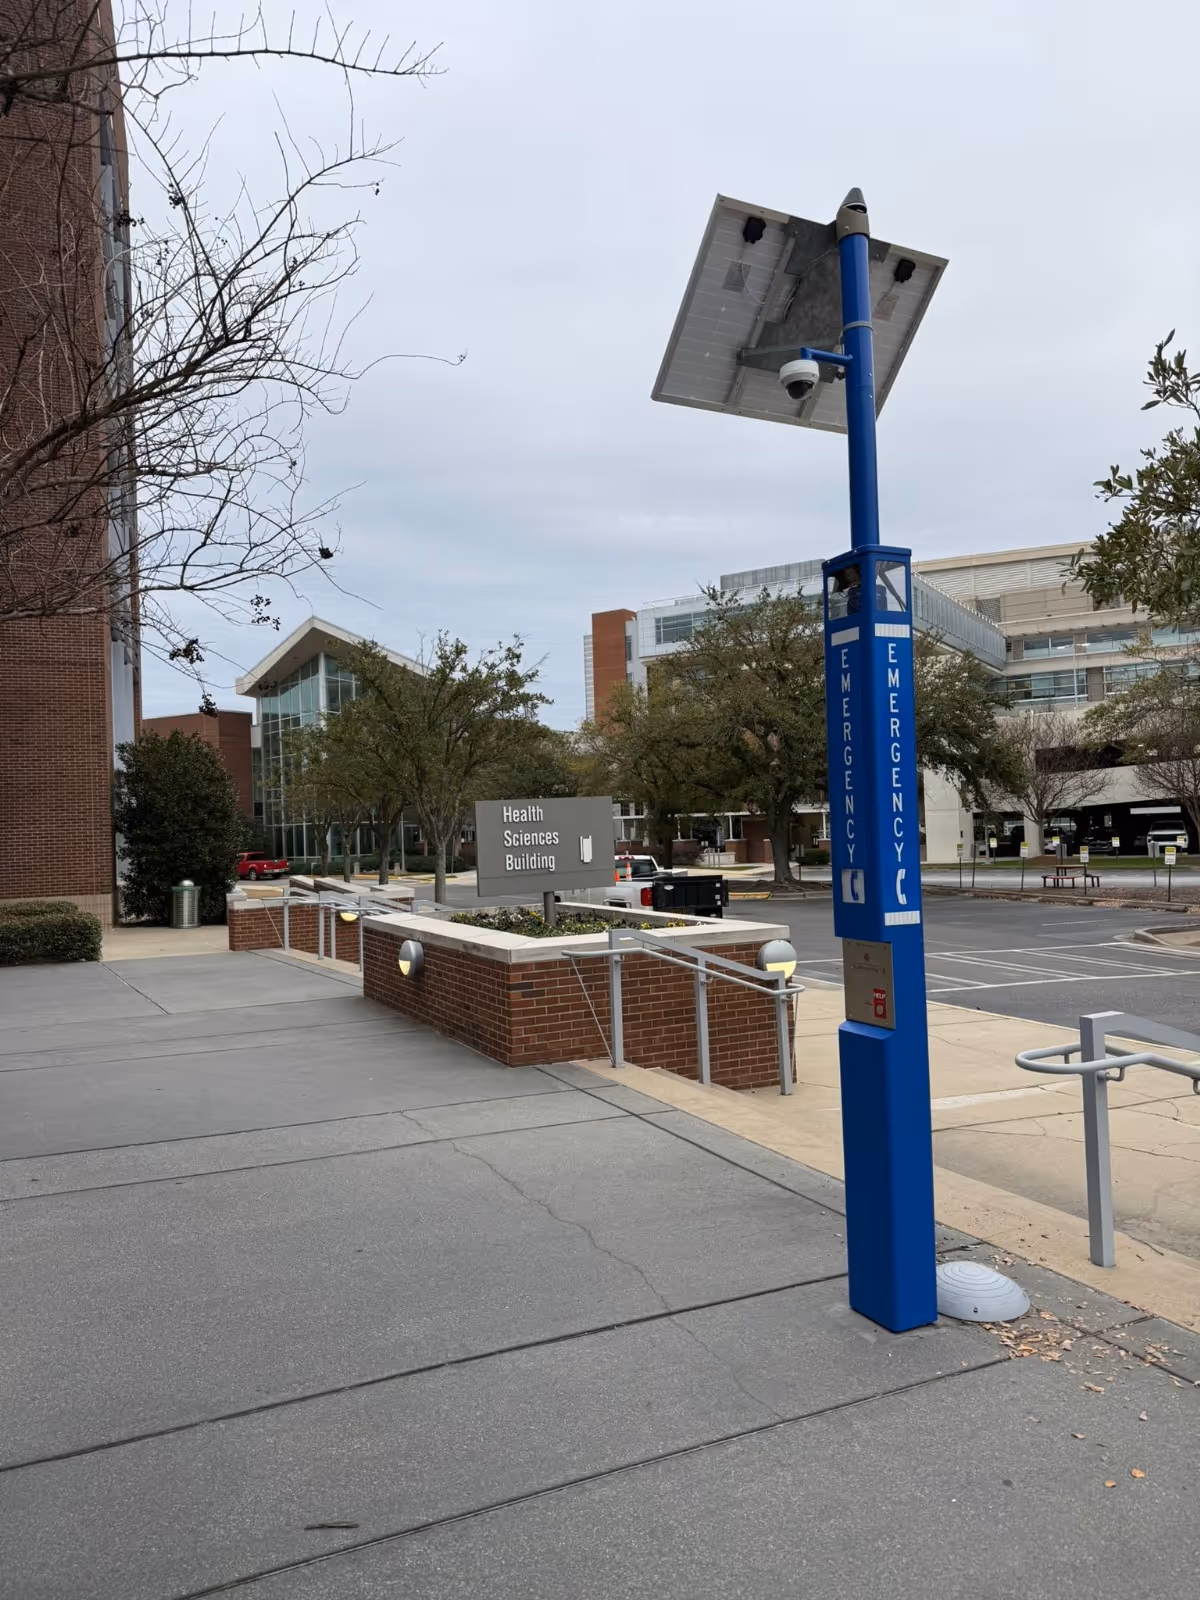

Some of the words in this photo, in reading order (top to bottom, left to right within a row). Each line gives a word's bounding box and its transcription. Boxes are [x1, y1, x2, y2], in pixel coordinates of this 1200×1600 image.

[841, 648, 855, 863] EMERGENCY
[888, 643, 904, 862] EMERGENCY
[503, 805, 543, 822] Health
[504, 830, 559, 847] Sciences
[505, 853, 555, 871] Building
